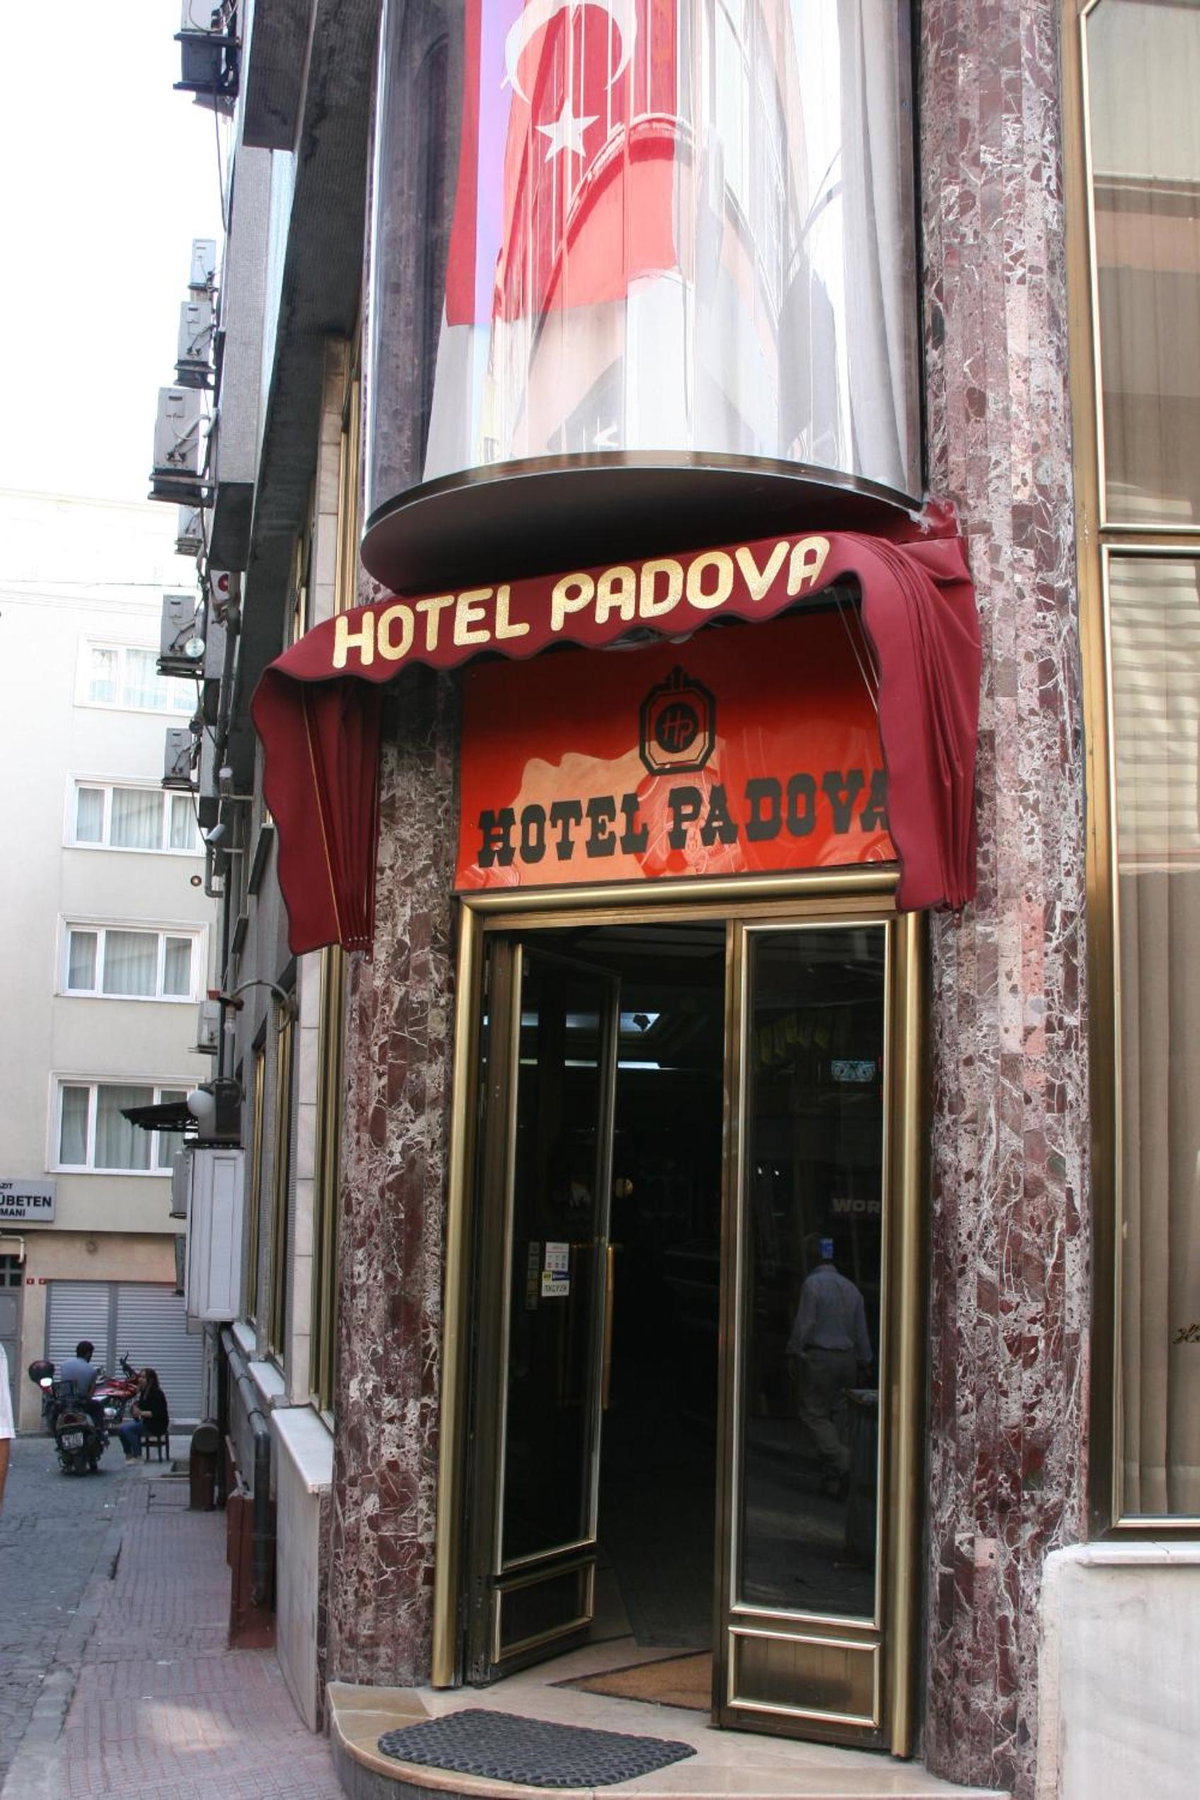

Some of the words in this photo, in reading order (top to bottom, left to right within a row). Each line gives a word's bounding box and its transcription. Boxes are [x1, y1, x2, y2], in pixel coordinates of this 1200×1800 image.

[332, 584, 531, 669] HOTEL
[550, 535, 831, 632] PADOVA
[478, 792, 650, 868] HOTEL
[668, 769, 888, 850] PADOVA
